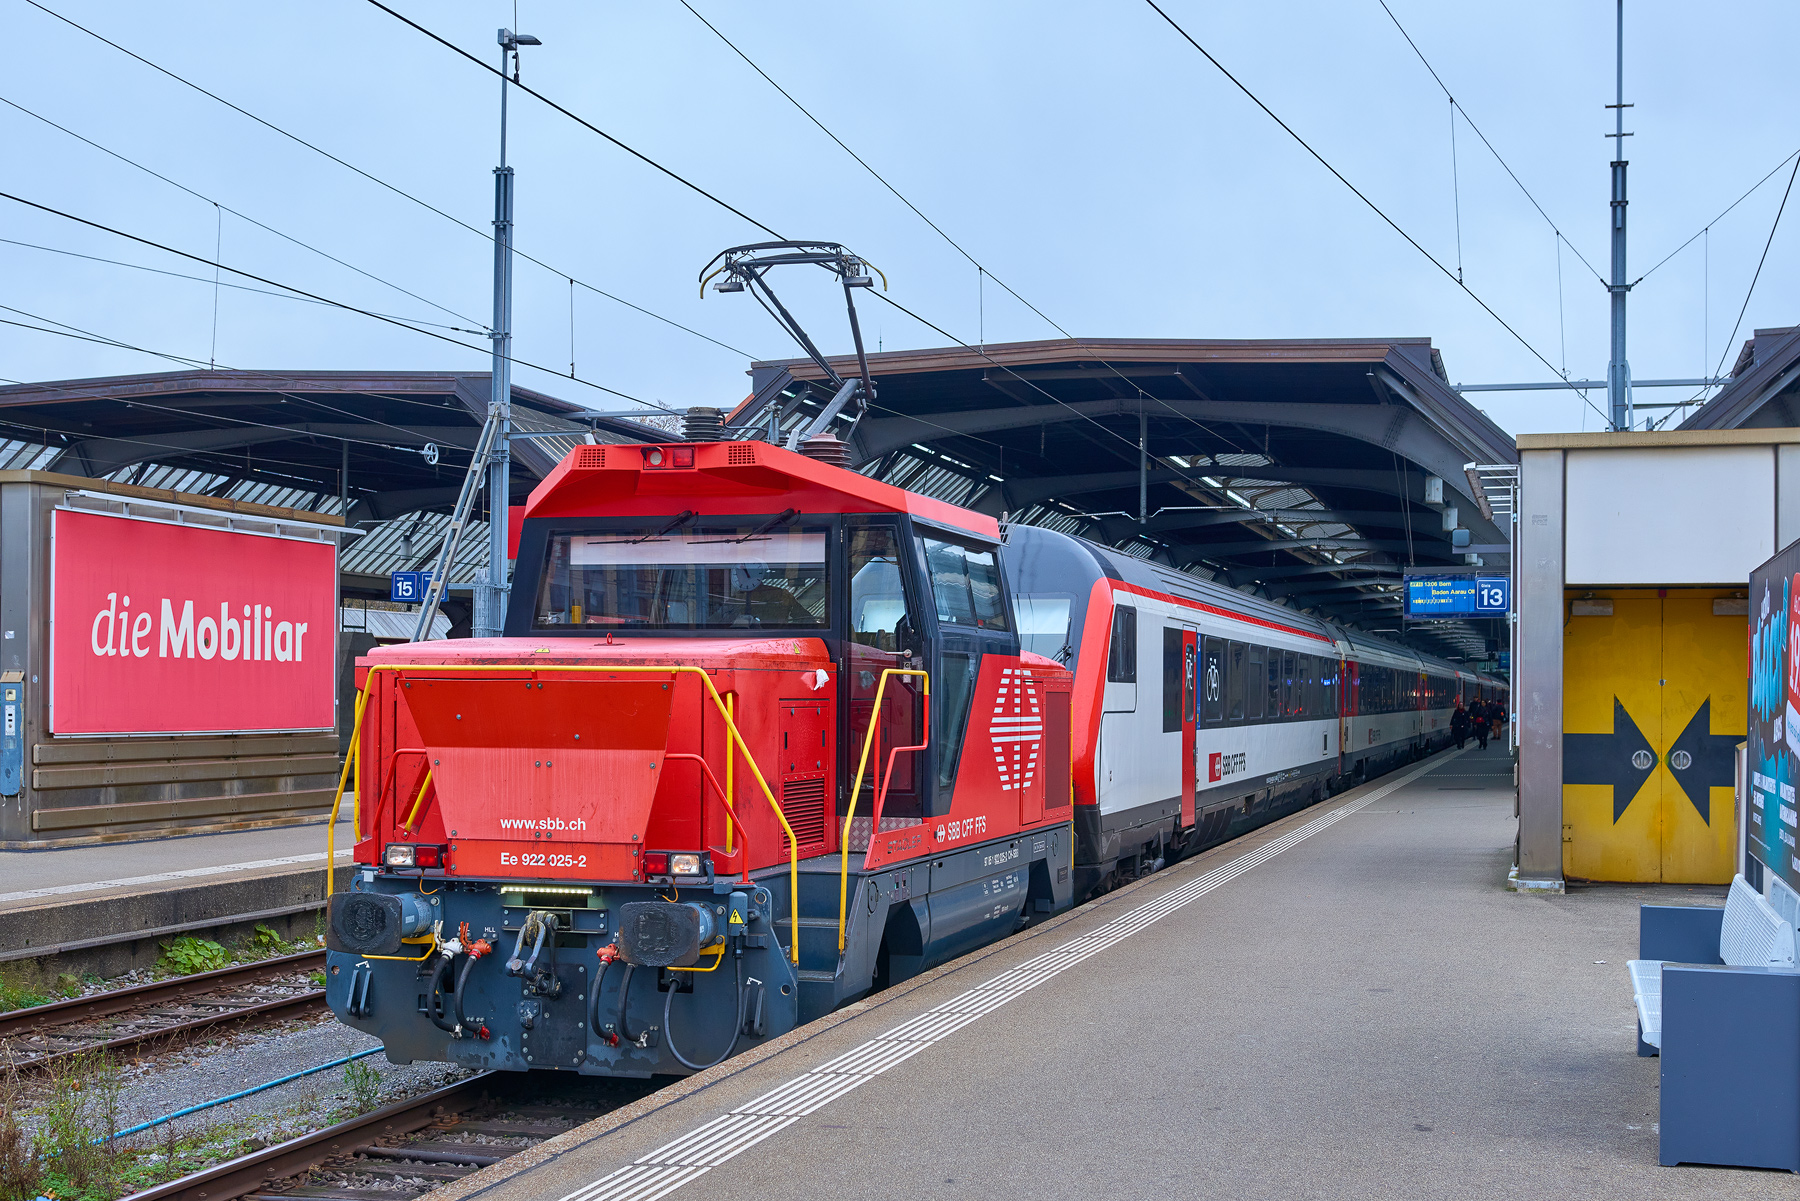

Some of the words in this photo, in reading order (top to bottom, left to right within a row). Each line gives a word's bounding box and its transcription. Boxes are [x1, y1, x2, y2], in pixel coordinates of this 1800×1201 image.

[396, 581, 413, 597] 15
[1481, 588, 1503, 606] 13
[91, 592, 152, 658] die
[159, 598, 308, 662] Mobiliar
[1222, 754, 1231, 776] SBB
[1230, 753, 1239, 774] CFF
[1238, 752, 1246, 772] FFS
[500, 817, 586, 831] www.sbb.ch
[947, 820, 961, 841] SBB
[961, 818, 974, 838] CFF
[975, 815, 987, 834] FFS
[887, 834, 922, 854] STADLER
[500, 852, 518, 865] Ee
[521, 853, 546, 866] 922
[549, 854, 587, 867] 025-2
